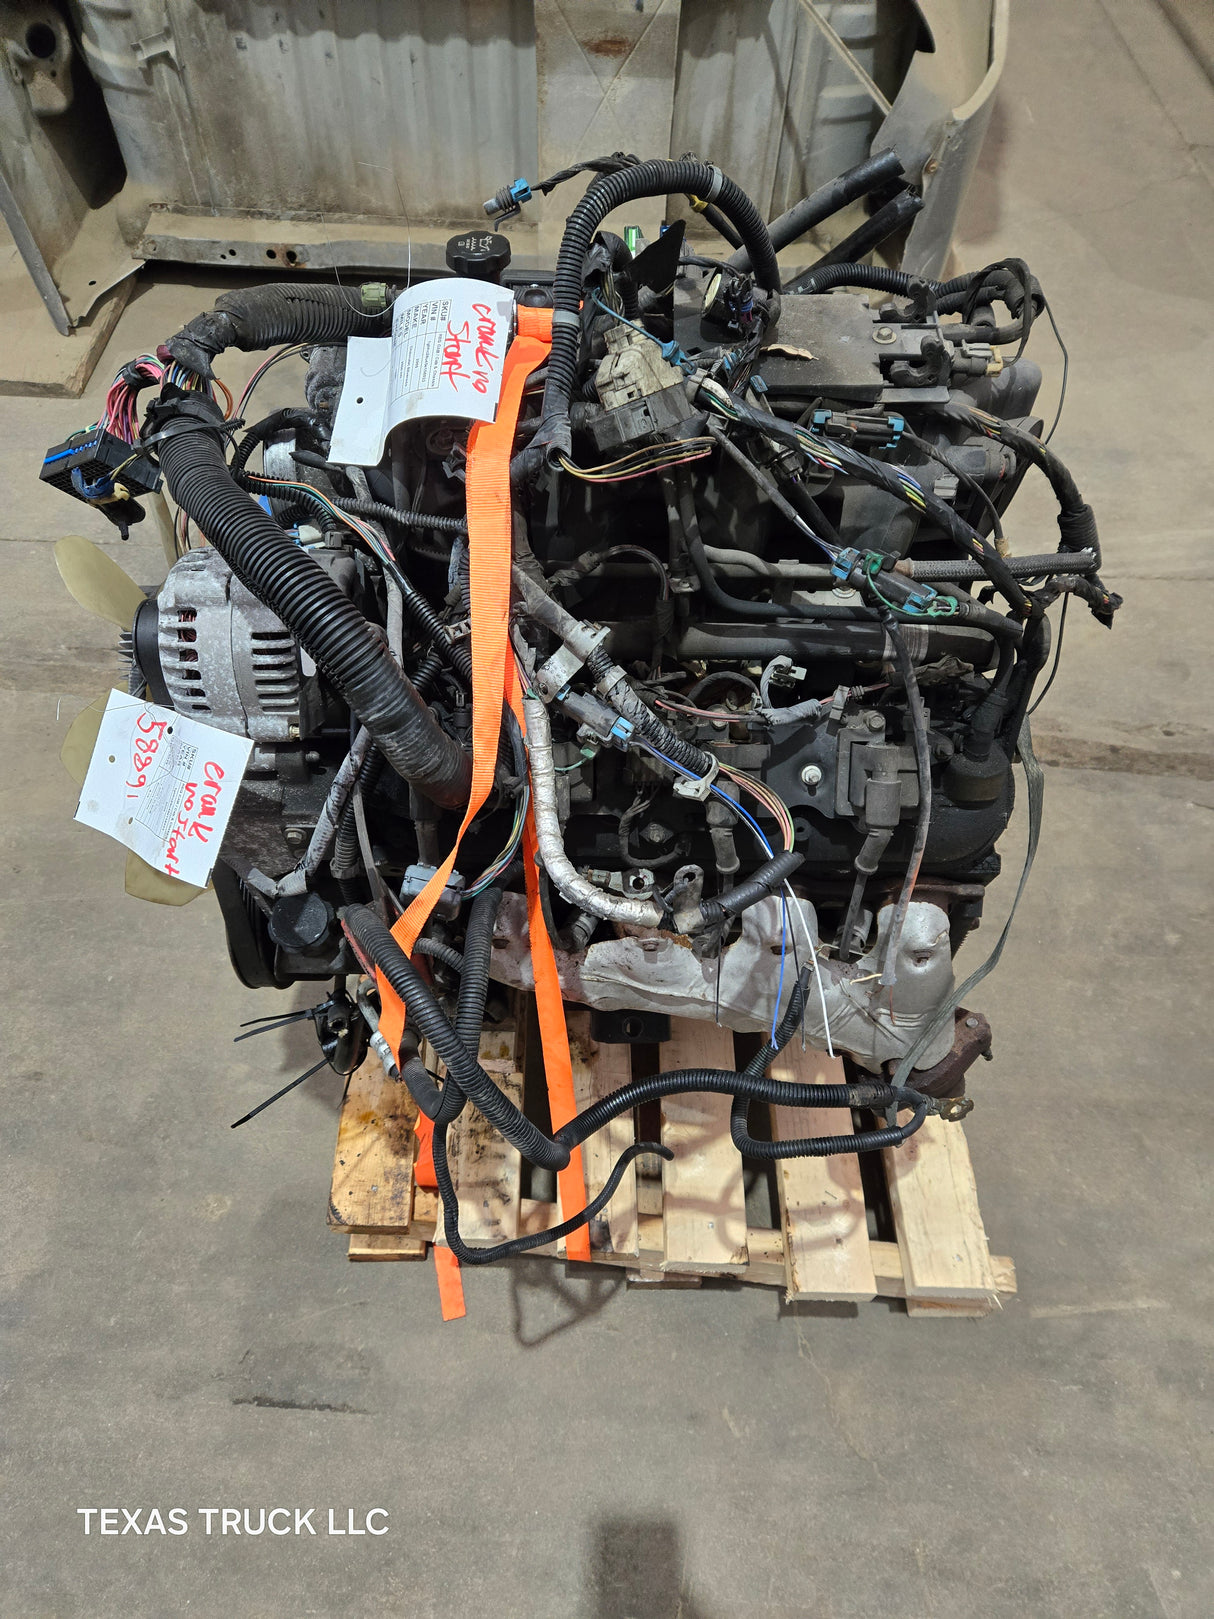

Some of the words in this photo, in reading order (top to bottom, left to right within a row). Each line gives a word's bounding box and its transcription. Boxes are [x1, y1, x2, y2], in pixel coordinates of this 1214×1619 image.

[412, 305, 420, 329] MAKE
[420, 303, 428, 325] YEAR
[440, 301, 449, 321] SKU#
[126, 713, 168, 798] 58891
